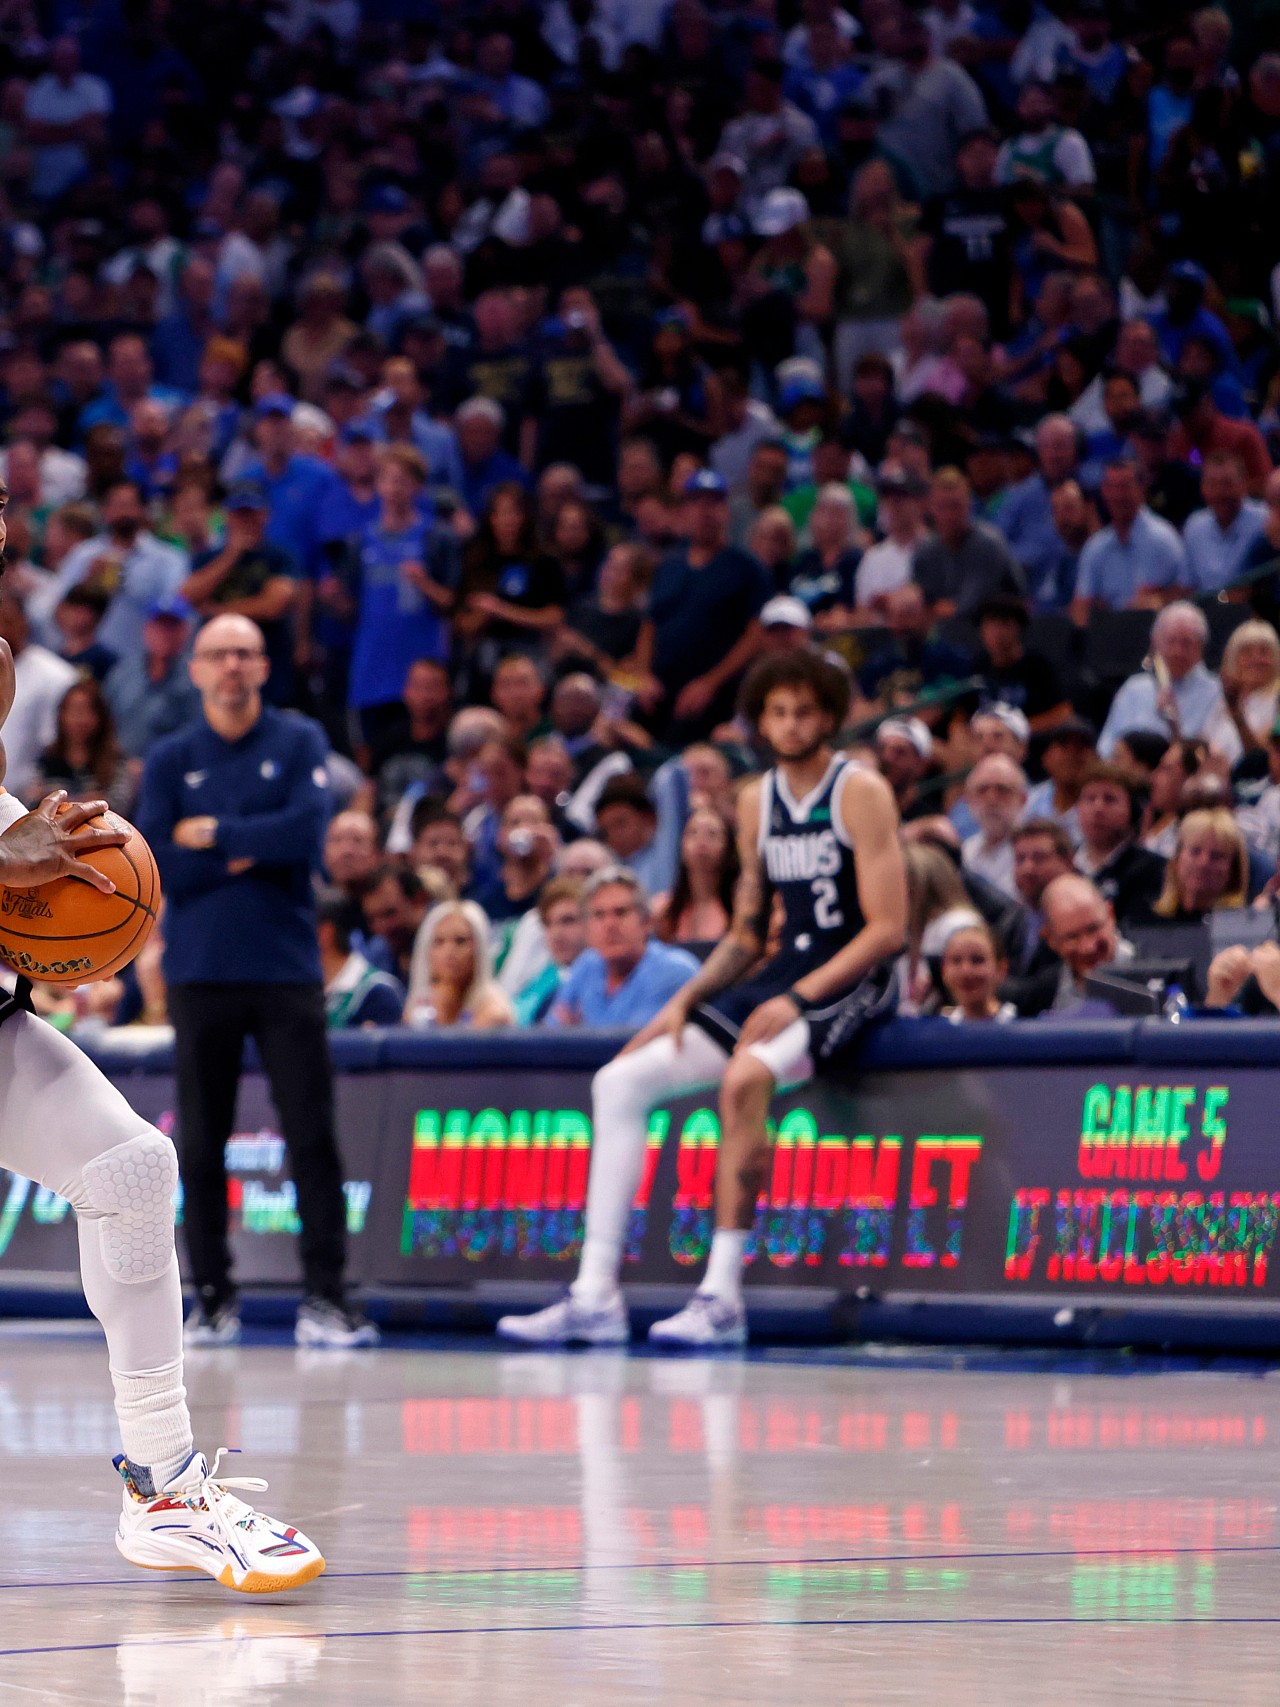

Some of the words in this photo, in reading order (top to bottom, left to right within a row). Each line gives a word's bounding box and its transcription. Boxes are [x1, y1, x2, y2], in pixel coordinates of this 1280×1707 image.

[766, 832, 839, 881] MAVS
[6, 893, 54, 919] Finals
[811, 880, 843, 929] 2
[1078, 1082, 1198, 1182] GAME
[1196, 1084, 1230, 1182] 5
[401, 1107, 671, 1264] MONDY
[902, 1134, 985, 1270] ET
